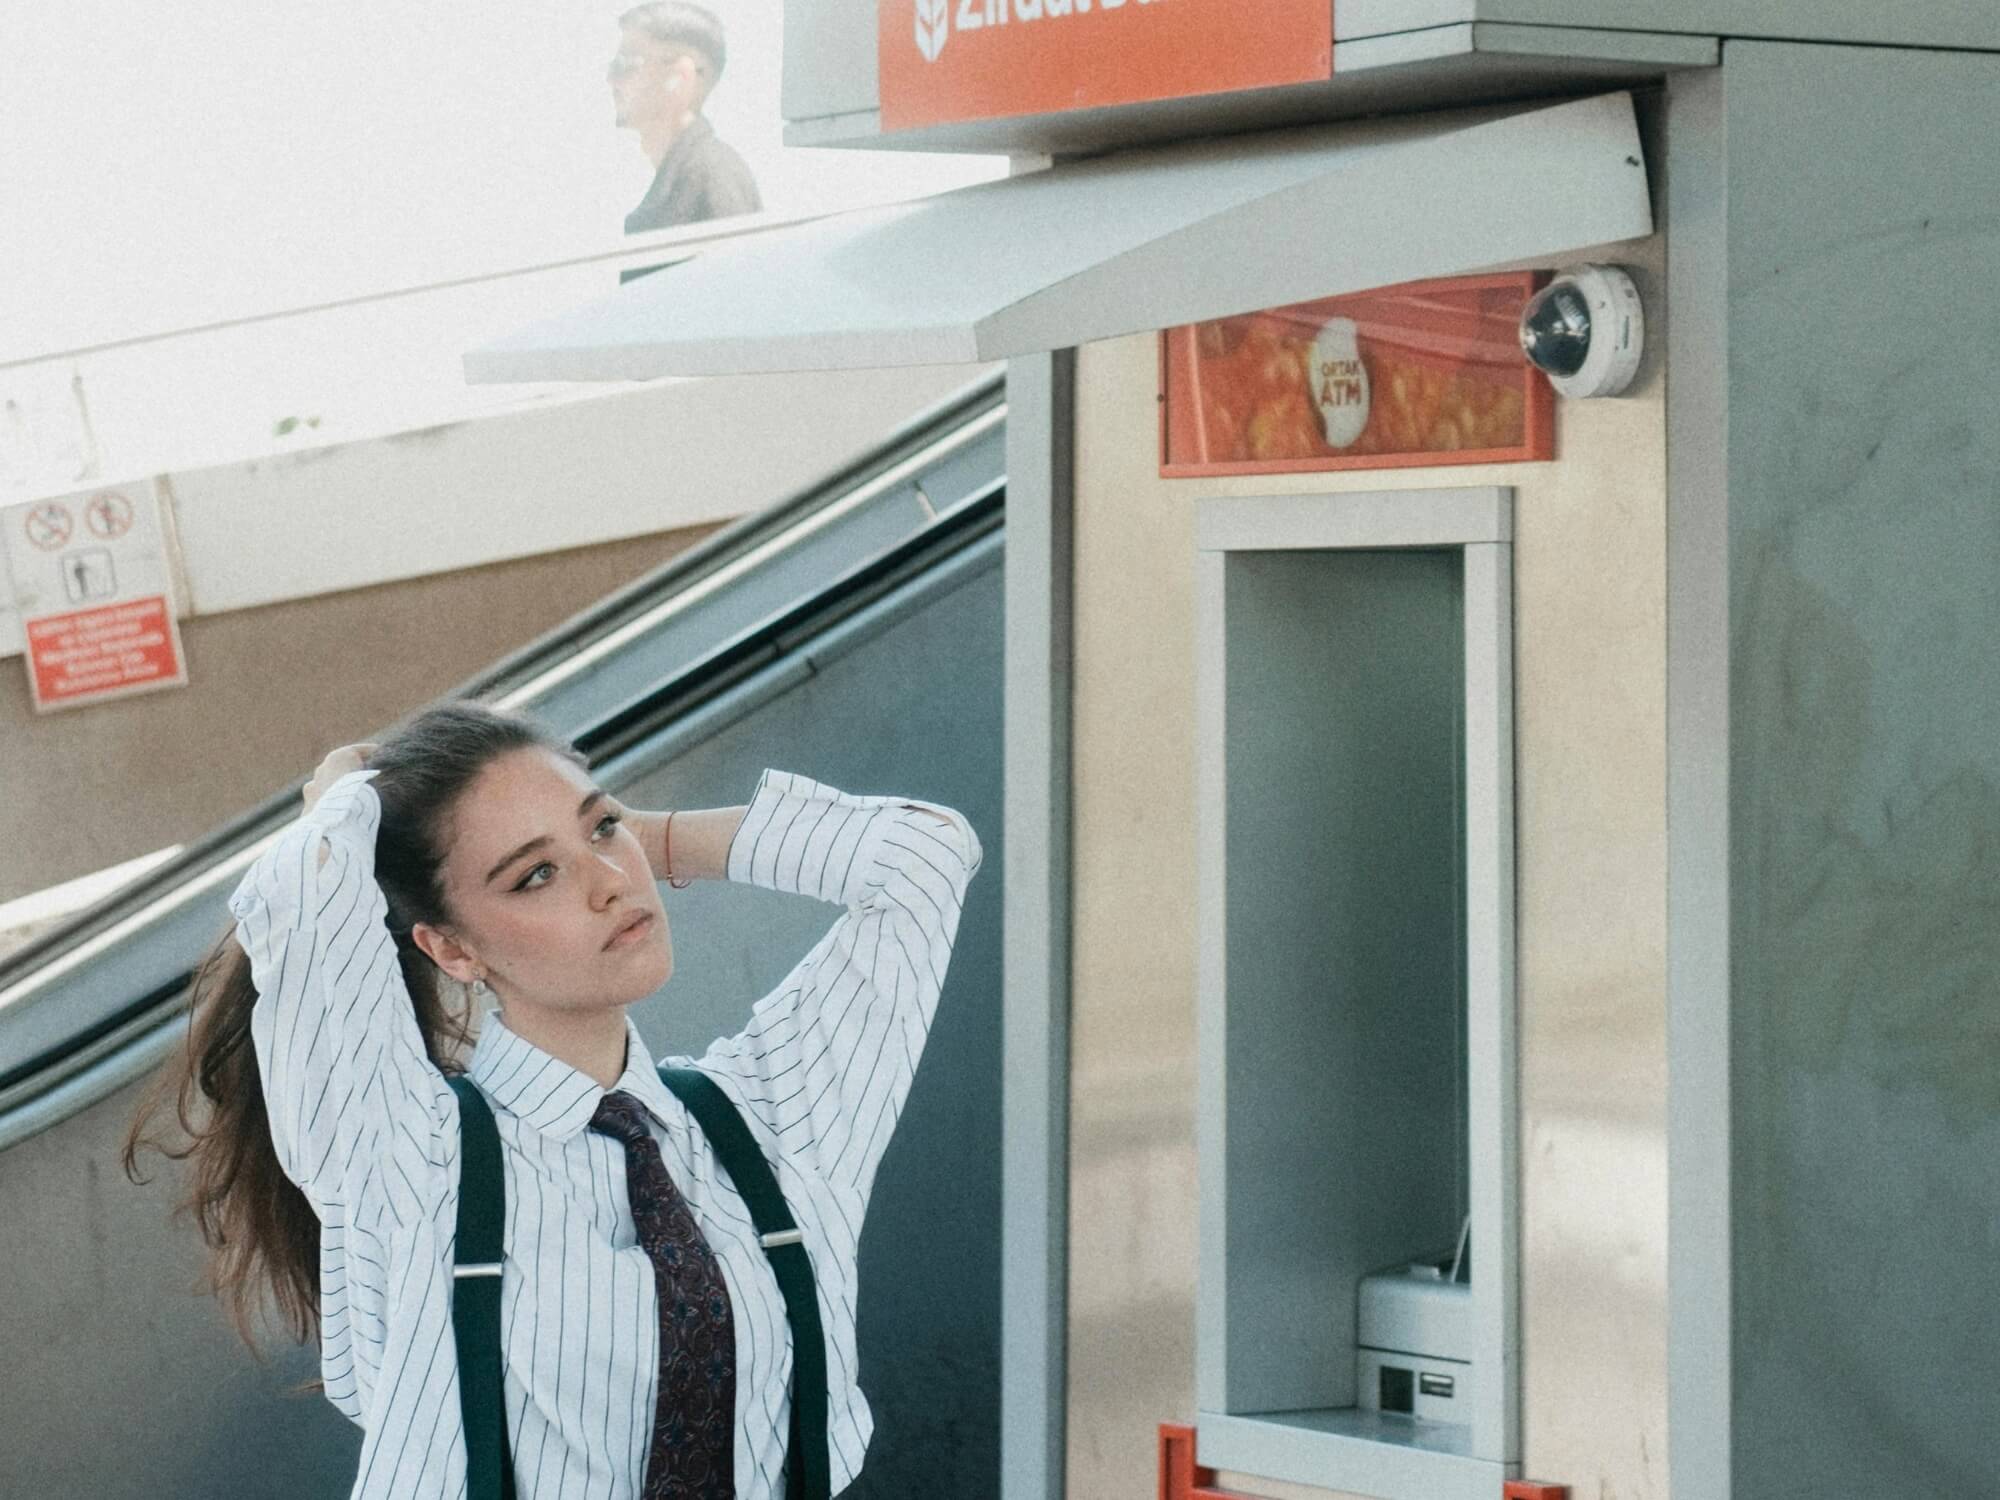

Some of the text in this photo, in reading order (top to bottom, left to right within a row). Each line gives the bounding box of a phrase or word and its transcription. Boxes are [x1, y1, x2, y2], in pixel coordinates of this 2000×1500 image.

[956, 0, 1091, 31] Zira
[1321, 360, 1361, 377] ORTAK
[1320, 379, 1362, 406] ATM
